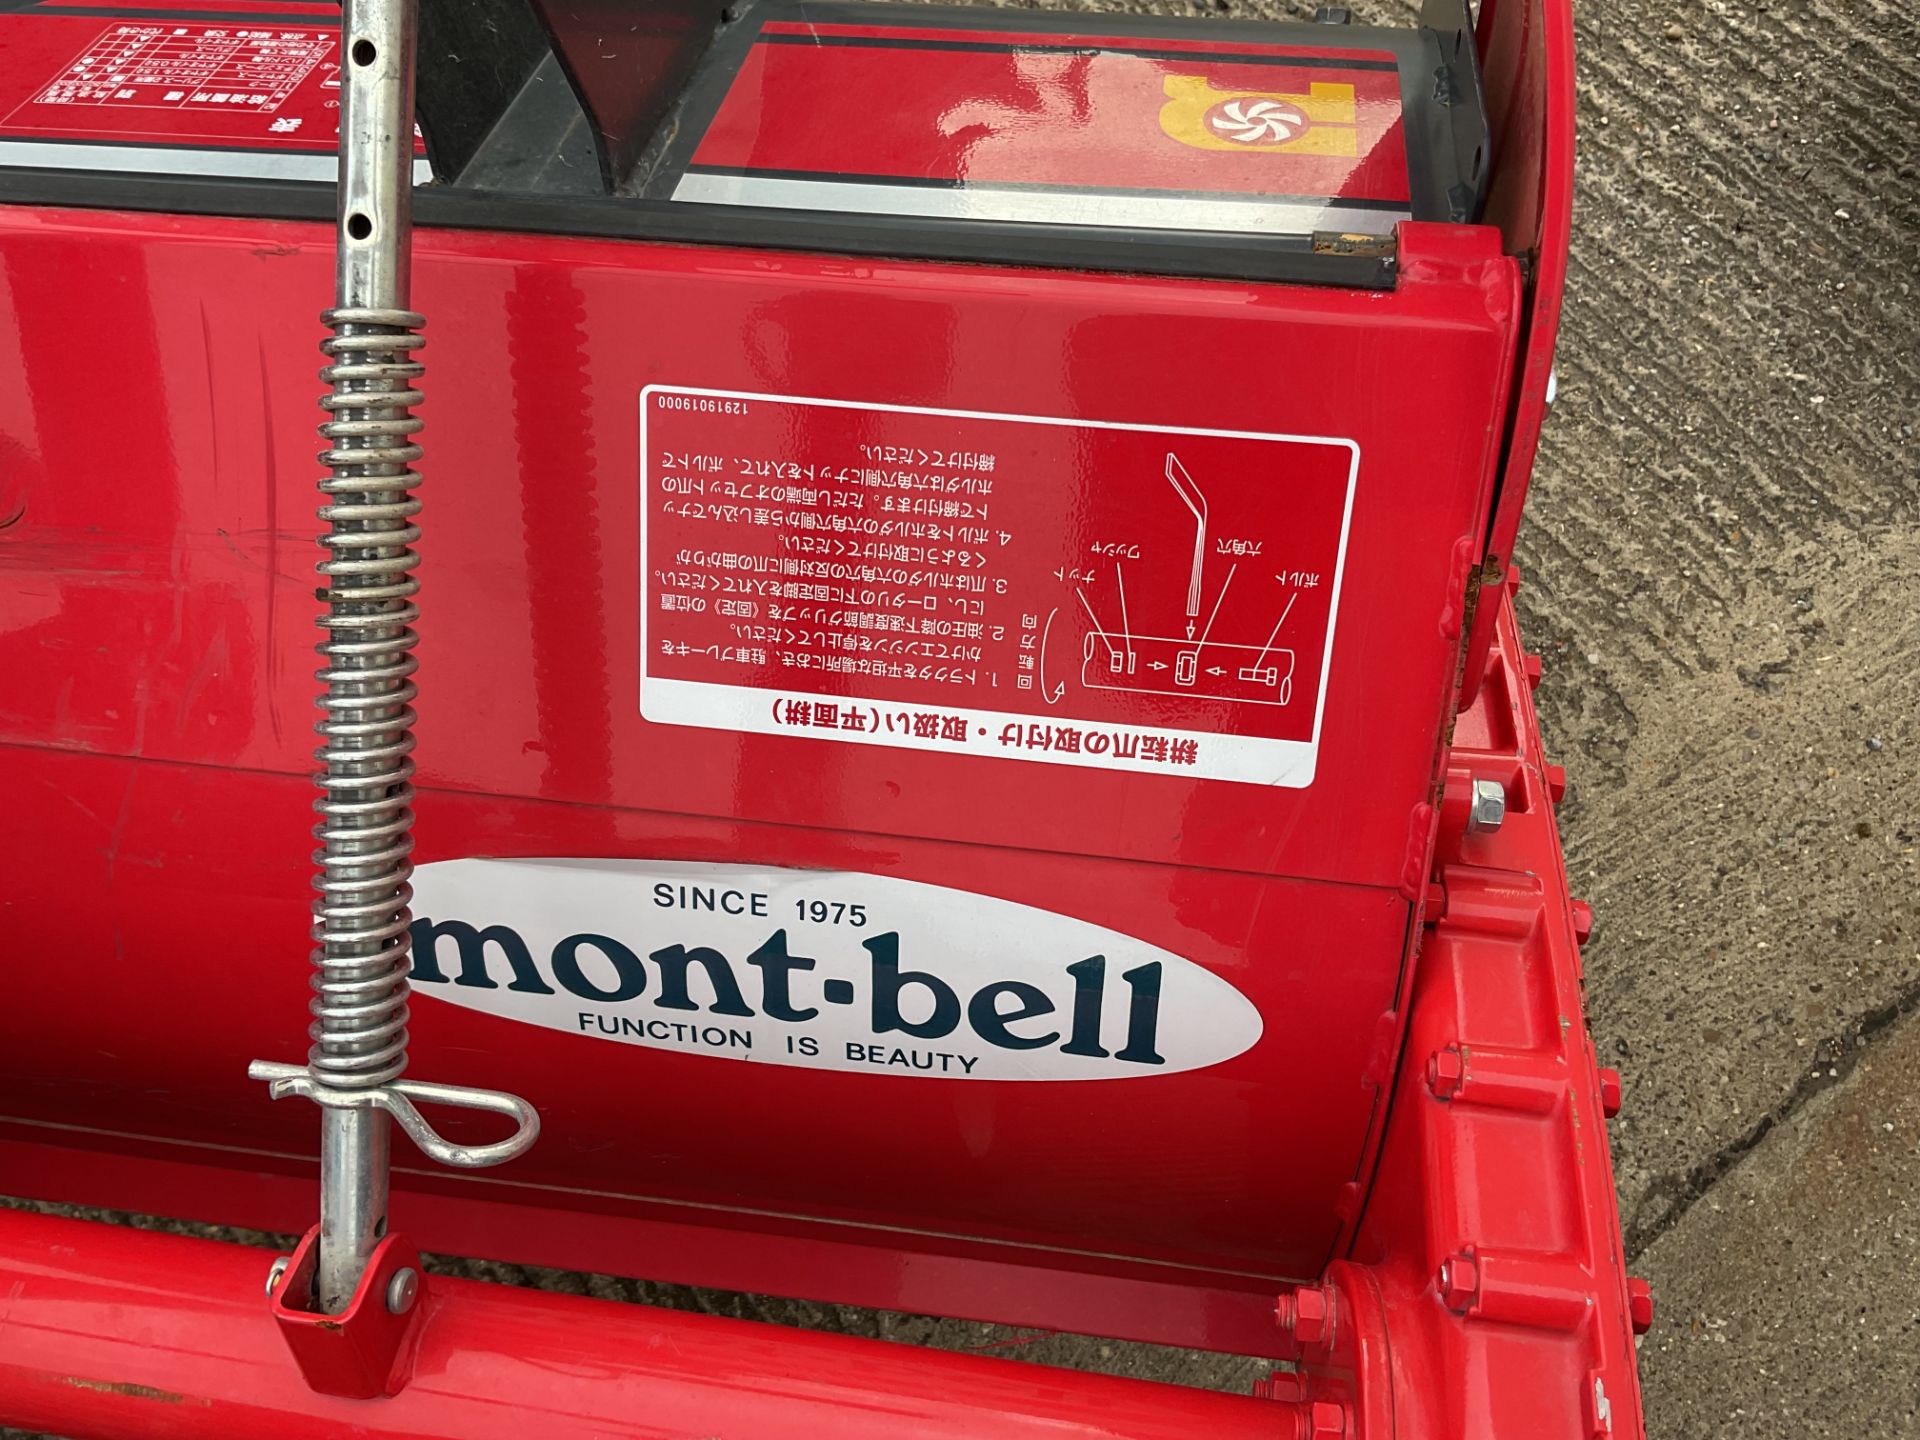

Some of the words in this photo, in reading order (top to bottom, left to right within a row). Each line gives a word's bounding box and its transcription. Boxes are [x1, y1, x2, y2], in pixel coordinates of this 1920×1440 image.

[658, 395, 749, 416] 12919019000
[661, 452, 993, 496] ホルダは六角穴側にナットを入れて、ボルトで
[859, 444, 996, 473] 締付けてください。
[661, 477, 988, 521] トで締付けます。ただし両端のオフセット爪の
[663, 501, 990, 545] ボルトをホルダの六角穴側から差し込んでナッ
[778, 535, 987, 569] くるように取付けてください。
[1090, 540, 1141, 559] ワッシャ
[1216, 537, 1263, 557] 六角穴
[654, 570, 985, 616] にし、ロータリの下に固定脚を入れてください。
[675, 549, 987, 593] 爪はホルダの六角穴の反対側に爪の曲がりが
[1053, 566, 1096, 585] ナット
[1274, 569, 1320, 589] ボルト
[661, 640, 977, 686] トラクタを平坦な場所におき、駐車ブレーキを
[729, 624, 982, 663] かけてエンジンを停止してください。
[1016, 613, 1038, 690] 回転方向
[653, 883, 768, 917] SINCE
[796, 899, 867, 927] 1975
[578, 1012, 753, 1049] FUNCTION
[786, 1036, 819, 1056] IS
[846, 1043, 979, 1074] BEAUTY
